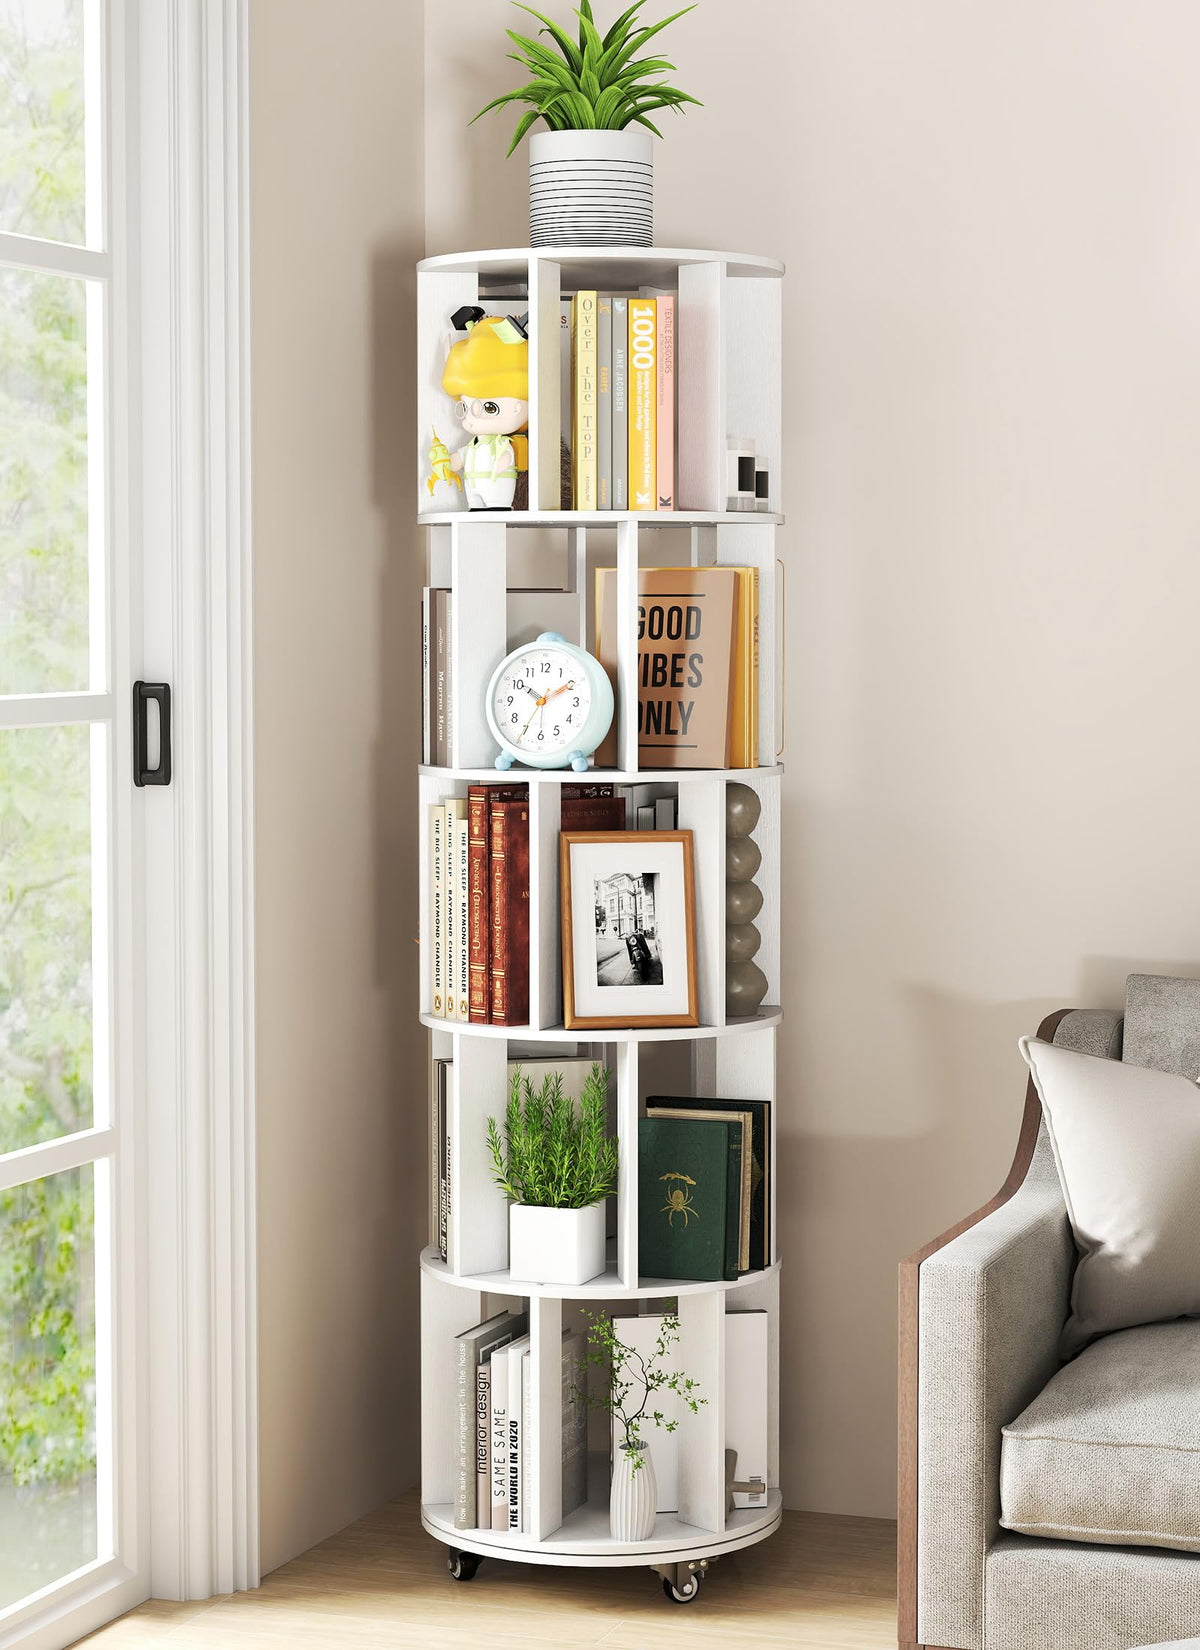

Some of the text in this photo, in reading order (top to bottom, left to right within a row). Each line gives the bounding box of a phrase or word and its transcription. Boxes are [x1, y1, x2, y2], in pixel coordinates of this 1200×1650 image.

[582, 298, 592, 349] Over
[632, 307, 654, 369] 1000
[584, 366, 592, 402] the
[526, 668, 534, 677] 11
[541, 663, 550, 673] 12
[560, 668, 562, 678] 1
[638, 652, 703, 688] IBES
[513, 680, 524, 689] 10
[567, 680, 575, 690] 2
[507, 696, 513, 706] 9
[573, 697, 579, 707] 3
[511, 713, 518, 723] 8
[566, 714, 571, 723] 4
[523, 725, 528, 735] 7
[538, 730, 544, 740] 6
[553, 726, 560, 736] 5
[473, 858, 482, 894] JOURNEY
[494, 873, 502, 925] UNEXPECTED
[473, 895, 481, 948] UNEXPECTED
[493, 925, 502, 959] JOURNEY
[458, 1343, 468, 1522] How to make an arrangement in the house
[477, 1372, 490, 1474] Interior design
[494, 1408, 505, 1496] SAME SAME
[510, 1421, 518, 1528] THE WORLD IN 2020
